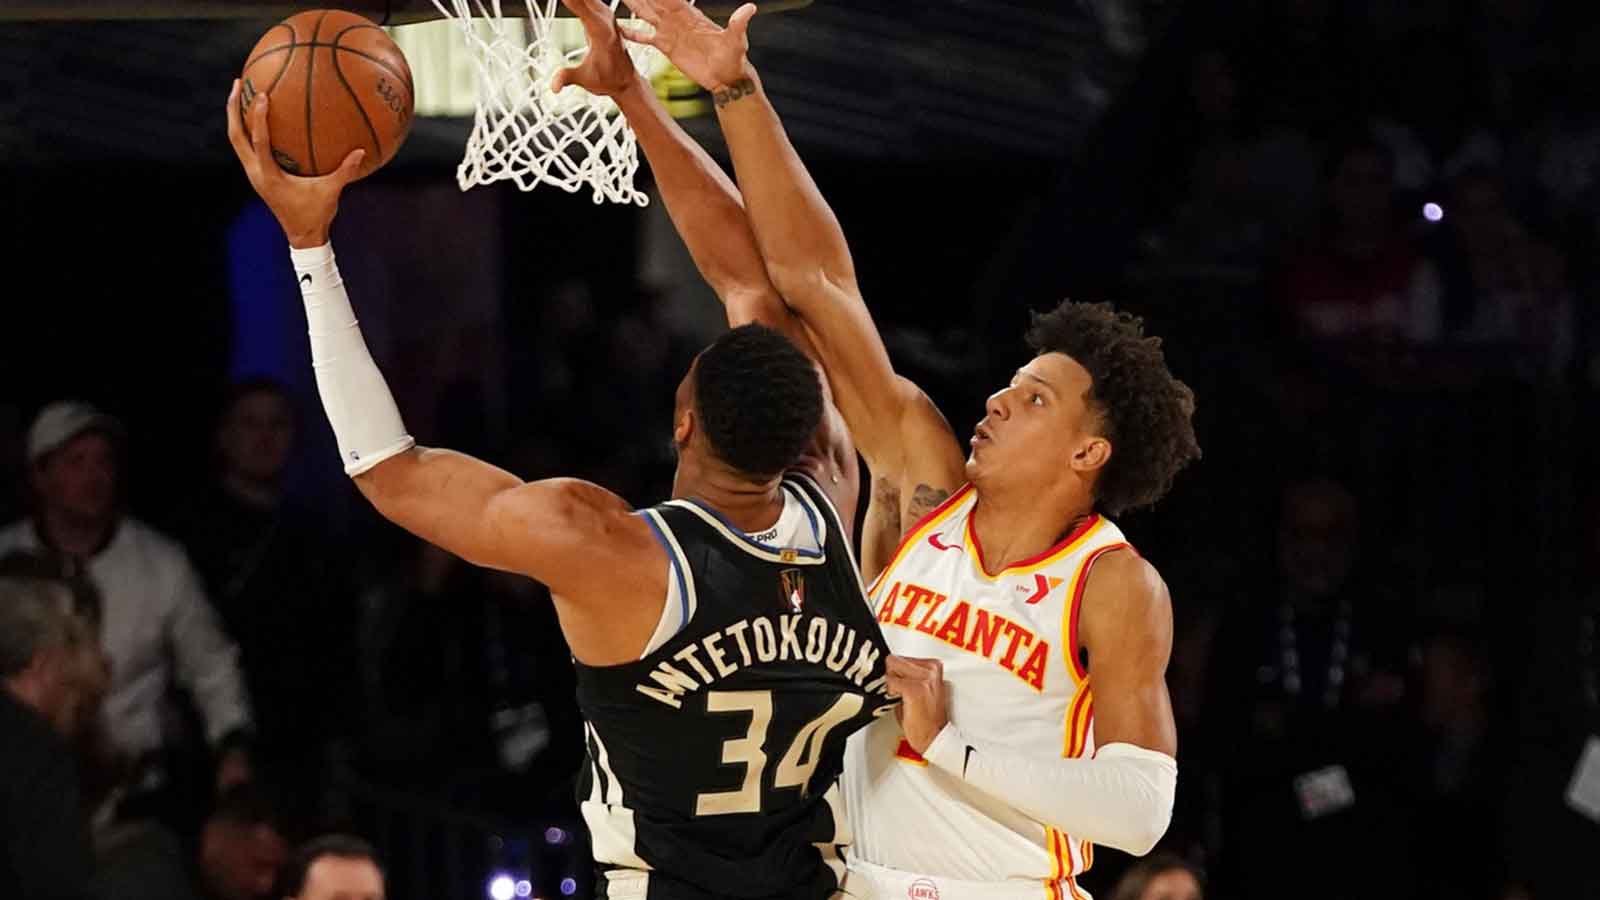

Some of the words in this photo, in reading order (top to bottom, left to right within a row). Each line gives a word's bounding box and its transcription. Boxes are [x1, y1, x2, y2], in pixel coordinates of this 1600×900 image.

[756, 528, 778, 542] PRO
[877, 581, 1049, 694] ATLANTA
[696, 690, 865, 816] 34
